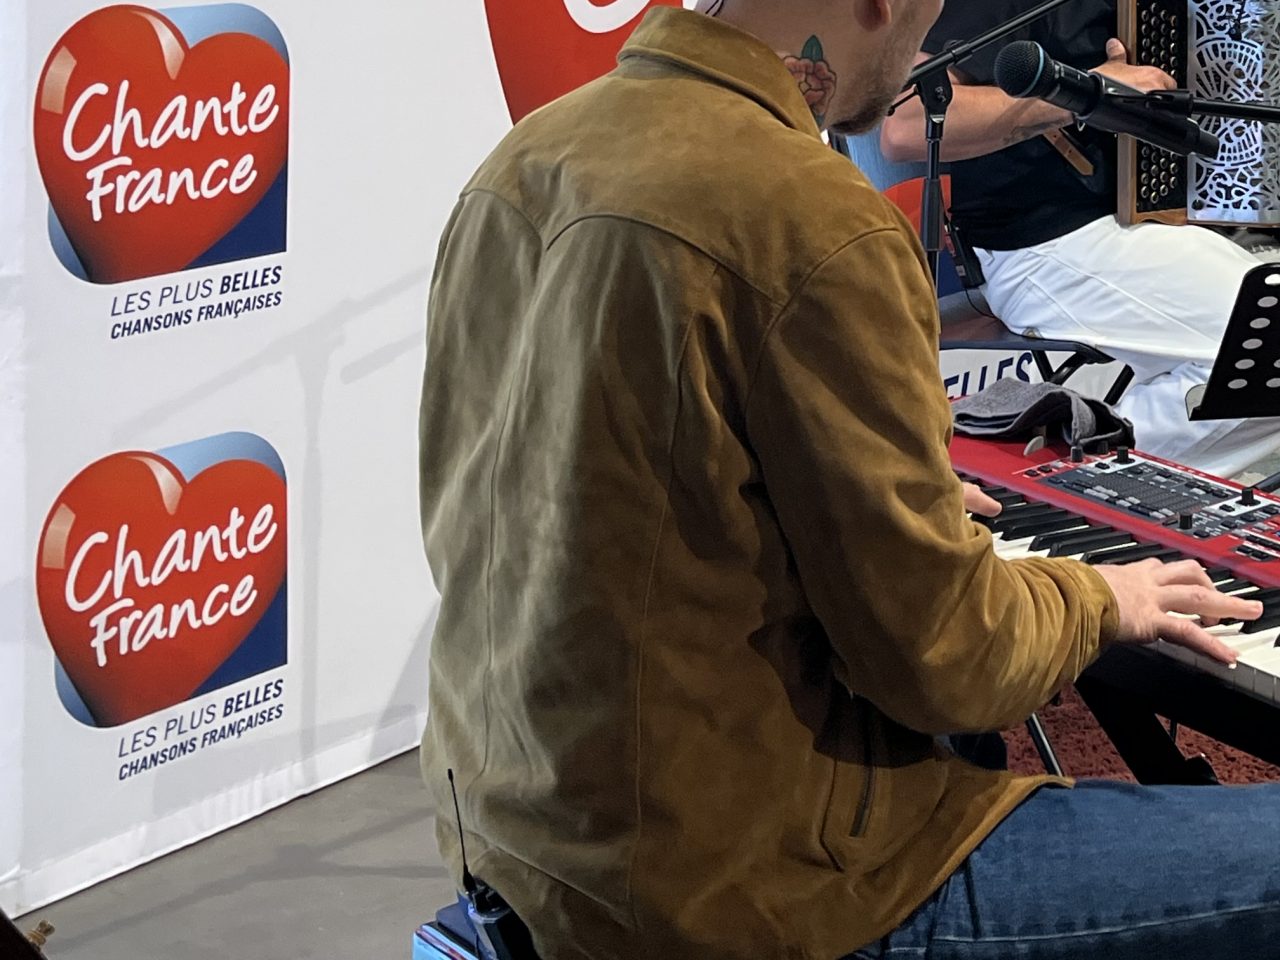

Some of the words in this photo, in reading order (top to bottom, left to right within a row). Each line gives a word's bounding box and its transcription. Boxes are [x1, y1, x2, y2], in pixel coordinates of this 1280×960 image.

[62, 80, 280, 162] Chante
[86, 153, 258, 222] France
[111, 290, 151, 318] LES
[158, 279, 213, 308] PLUS
[219, 266, 282, 296] BELLES
[111, 309, 192, 340] CHANSONS
[197, 291, 282, 323] FRANÇAISES
[64, 503, 278, 612] Chante
[90, 575, 258, 668] France
[118, 725, 157, 759] LES
[164, 705, 216, 741] PLUS
[222, 679, 284, 718] BELLES
[118, 739, 197, 781] CHANSONS
[201, 704, 284, 749] FRANÇAISES
